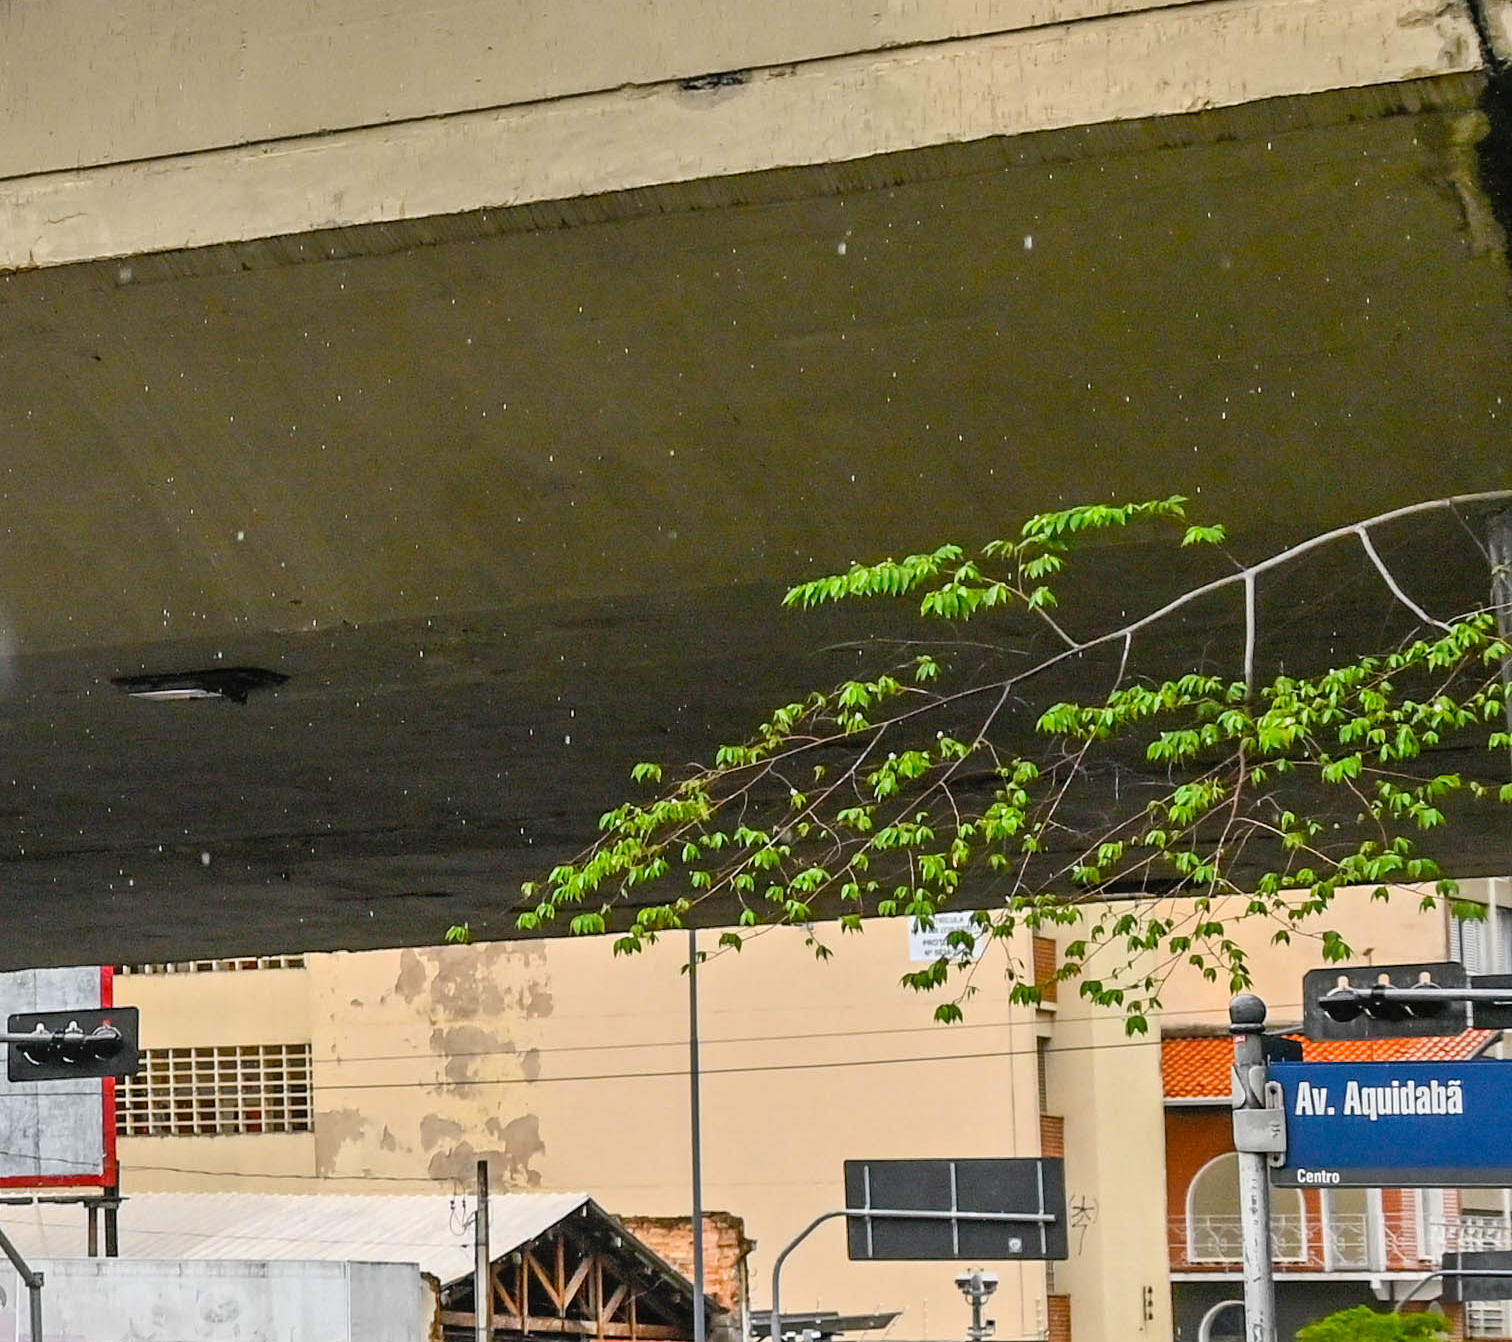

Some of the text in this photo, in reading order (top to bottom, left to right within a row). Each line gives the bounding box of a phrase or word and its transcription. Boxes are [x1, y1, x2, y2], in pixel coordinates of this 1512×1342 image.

[1295, 1080, 1463, 1121] Av. Aquidabã
[1297, 1168, 1340, 1184] Centro
